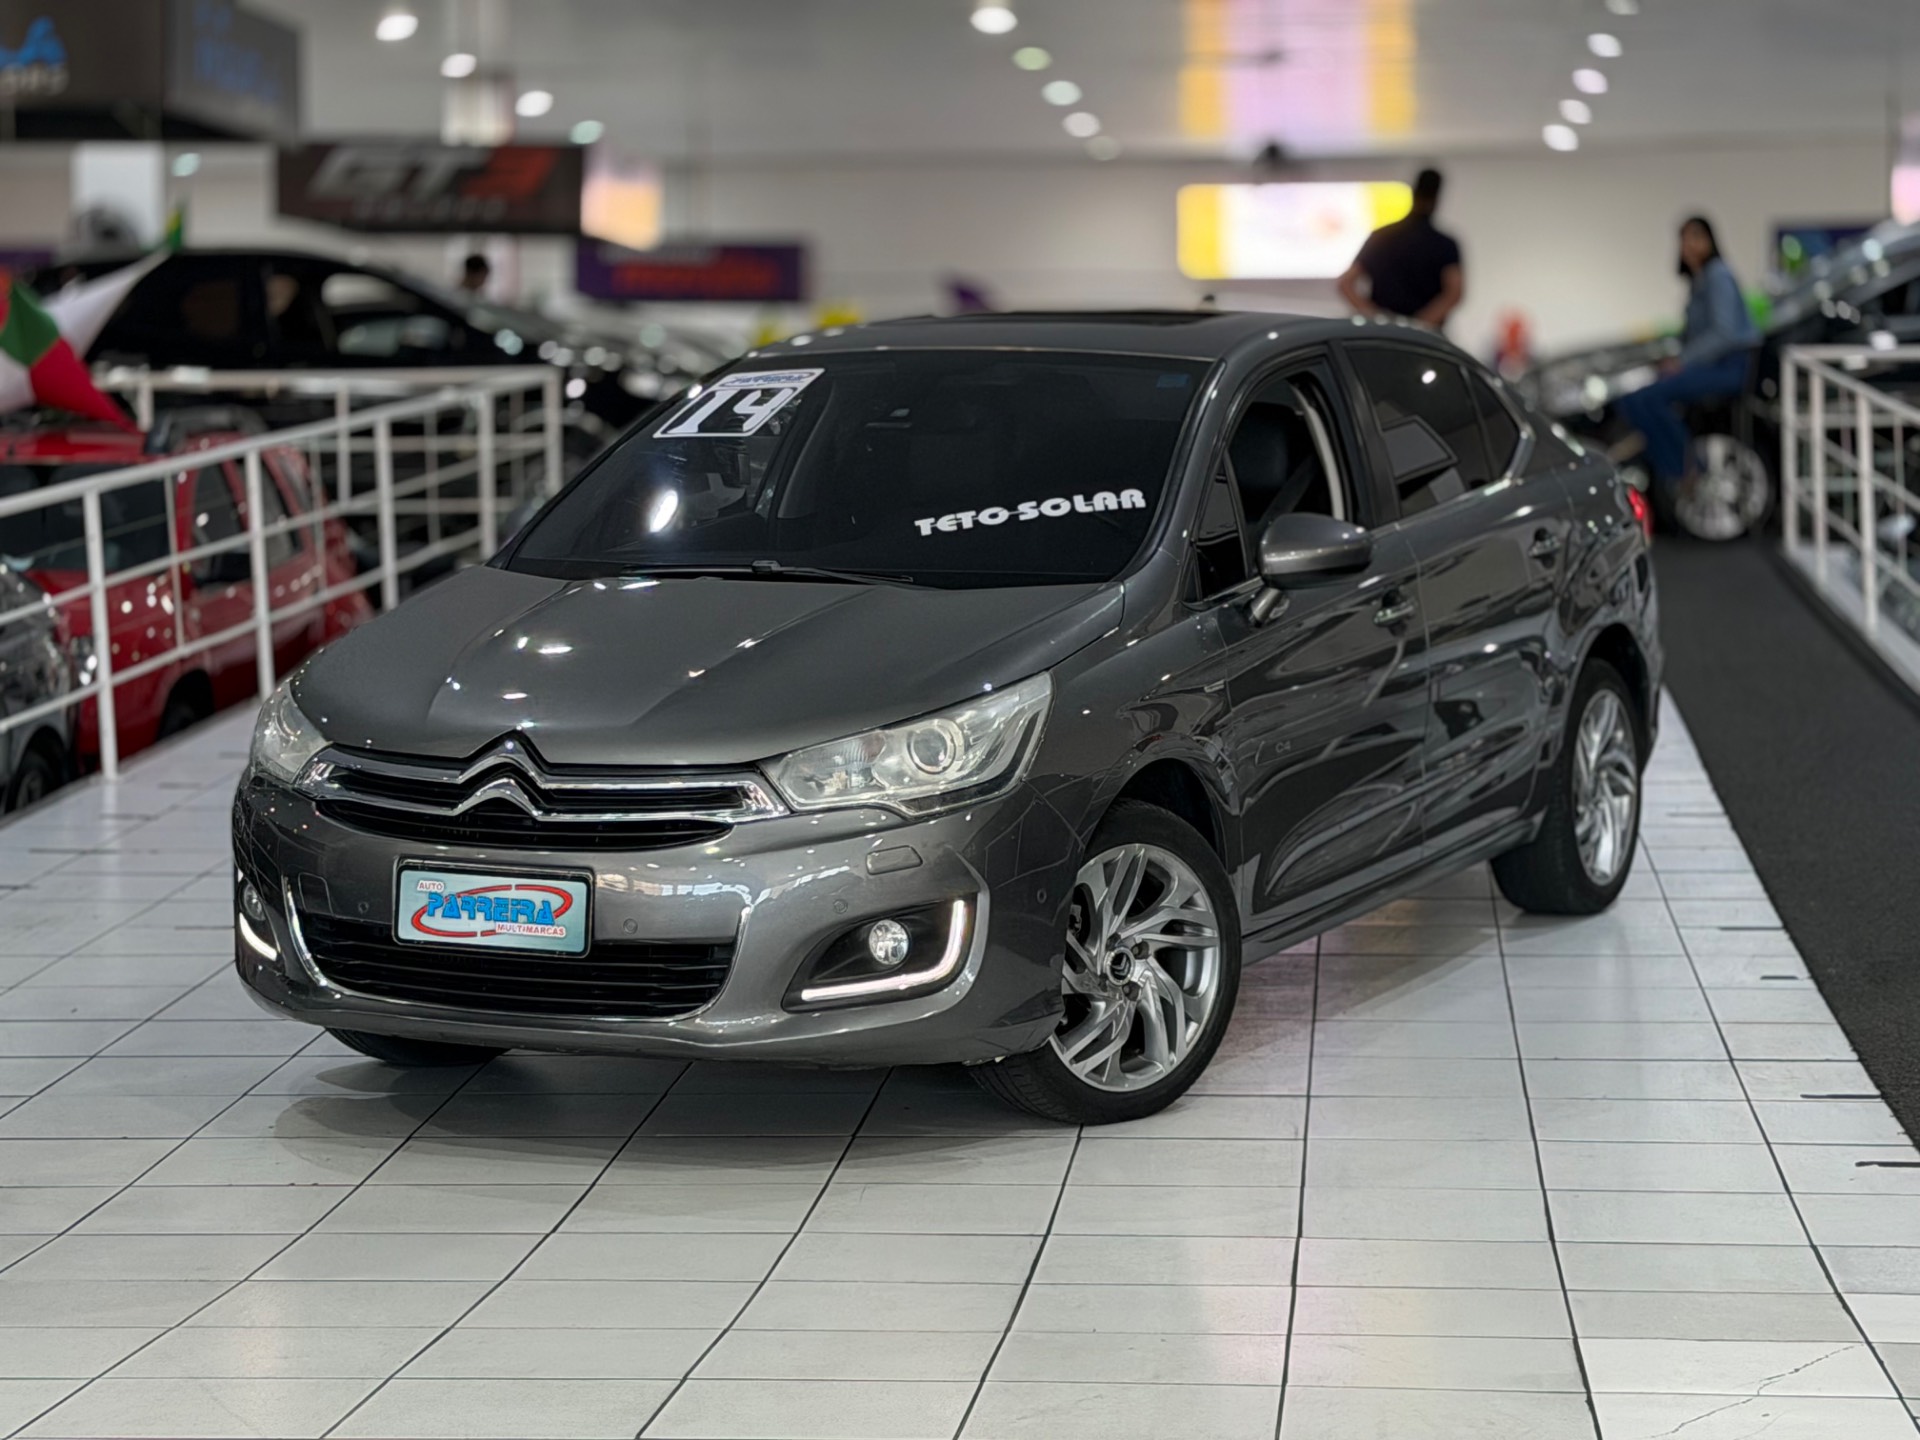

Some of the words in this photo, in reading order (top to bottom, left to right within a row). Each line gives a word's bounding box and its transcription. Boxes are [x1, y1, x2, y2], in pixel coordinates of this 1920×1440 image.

[666, 388, 794, 434] 14
[418, 881, 444, 891] AUTO
[426, 891, 556, 926] PARREIRA
[496, 923, 565, 936] MULTIMARCAS
